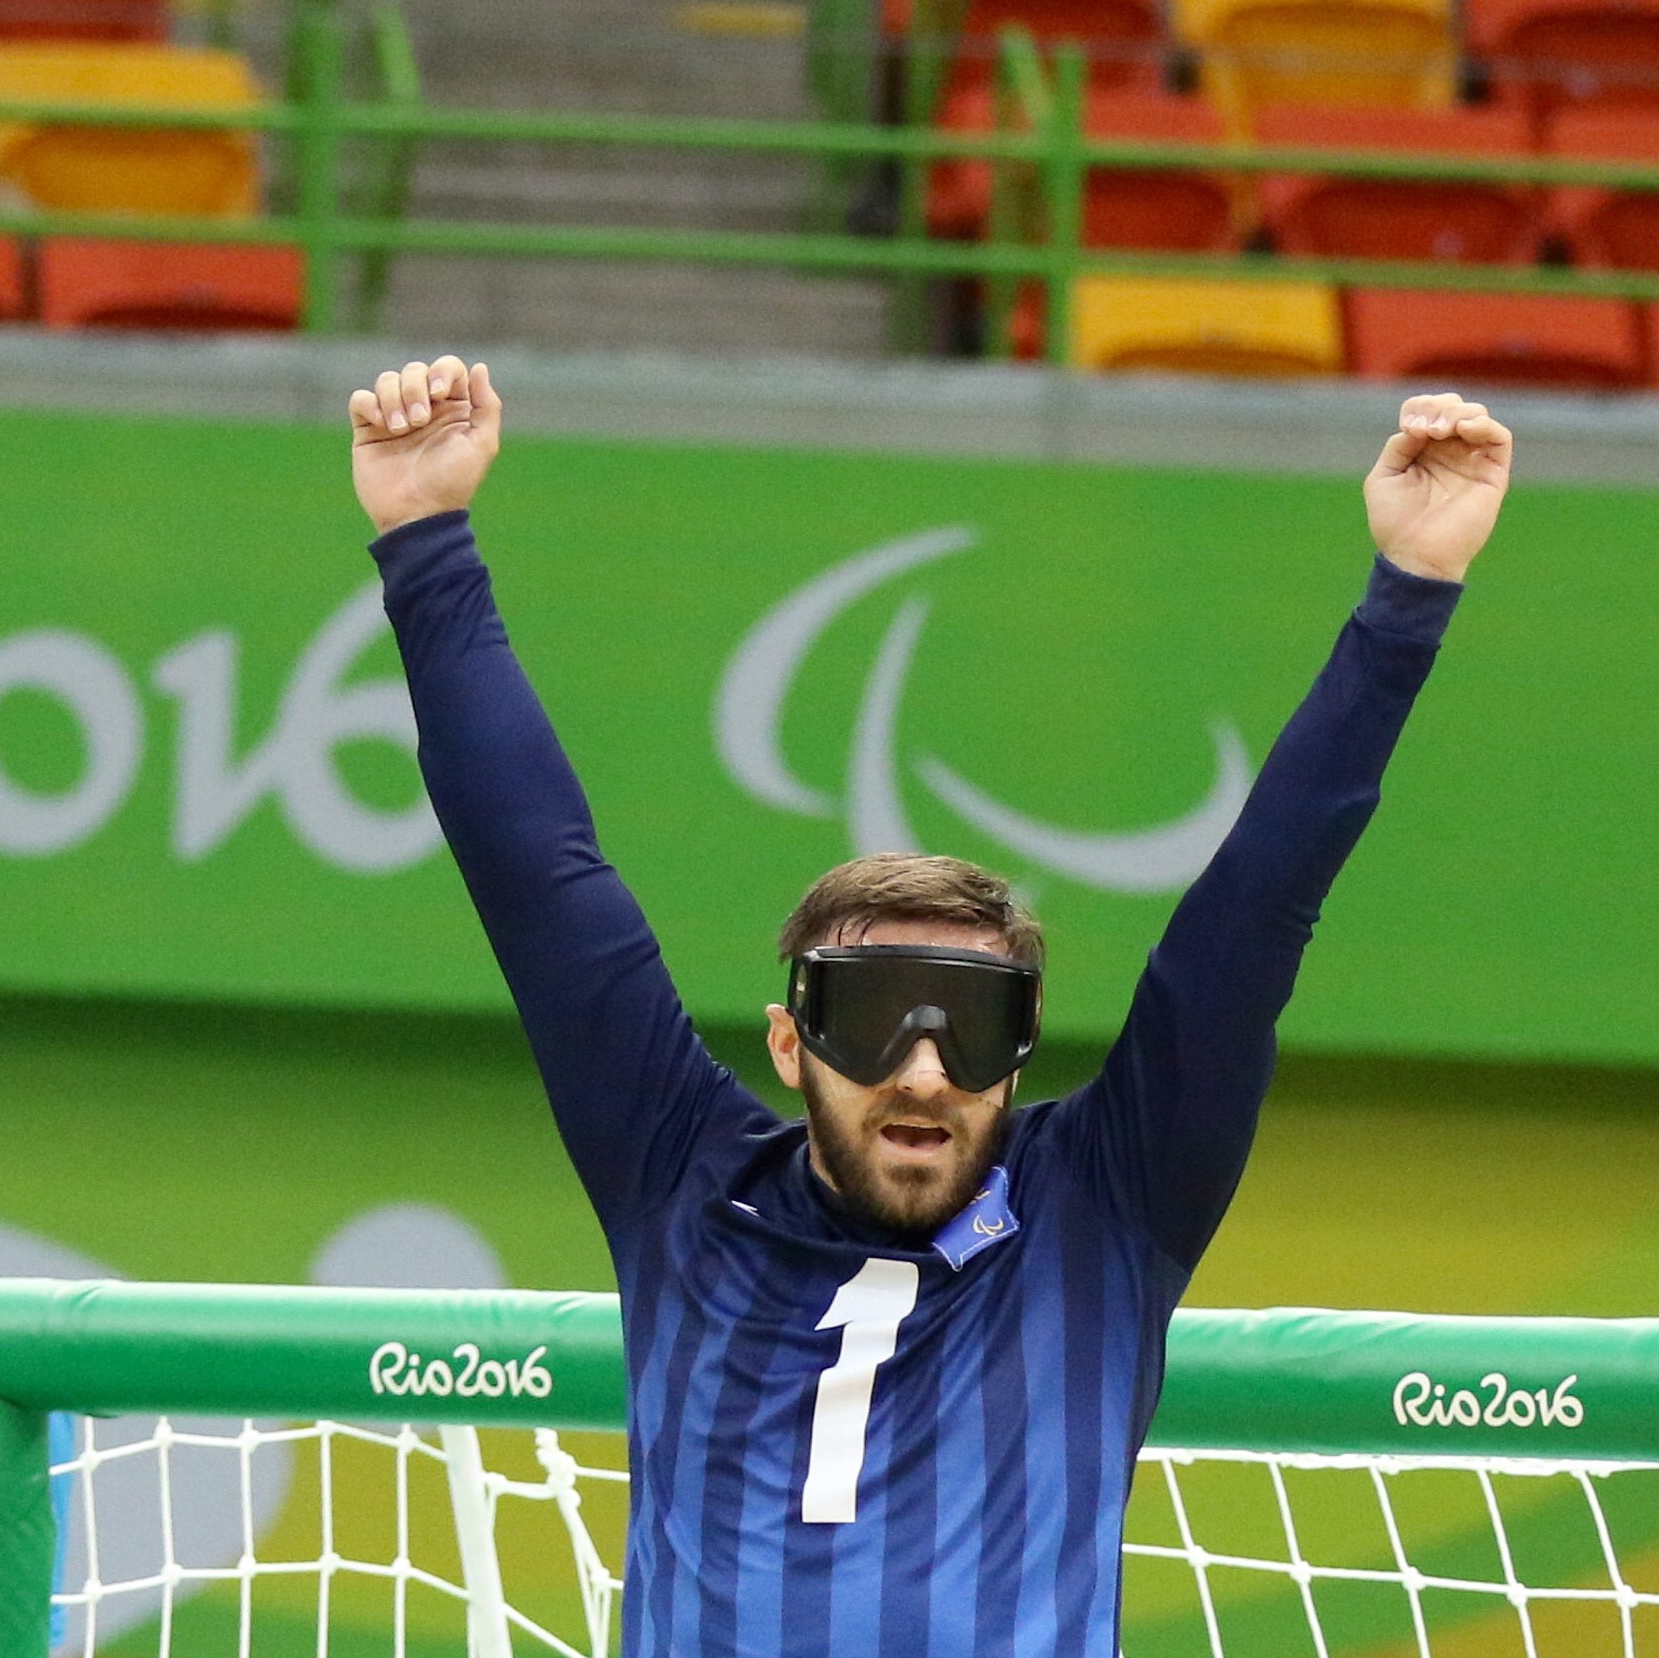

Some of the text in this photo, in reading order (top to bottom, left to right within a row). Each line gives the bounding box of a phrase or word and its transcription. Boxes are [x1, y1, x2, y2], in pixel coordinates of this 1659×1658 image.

[369, 1341, 553, 1398] Rio2016
[802, 1257, 919, 1523] 1
[1393, 1372, 1584, 1428] Rio2016
